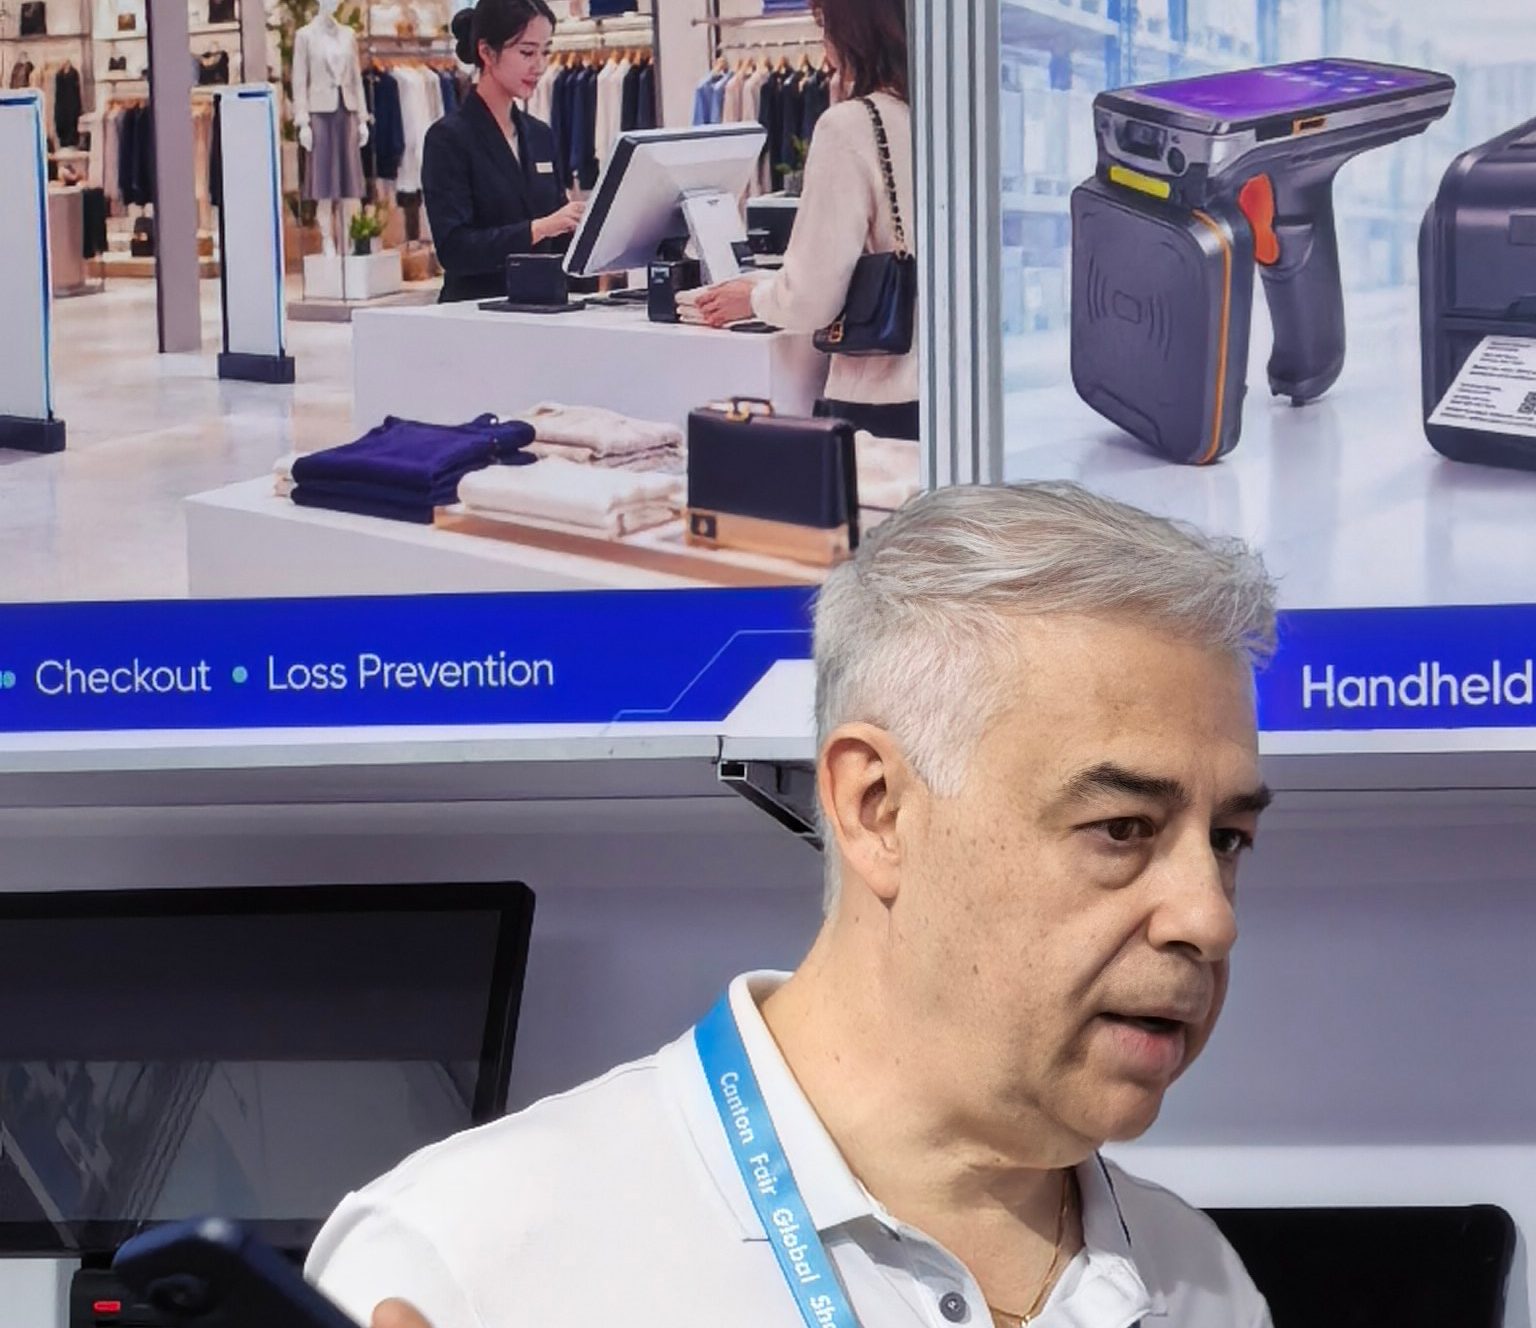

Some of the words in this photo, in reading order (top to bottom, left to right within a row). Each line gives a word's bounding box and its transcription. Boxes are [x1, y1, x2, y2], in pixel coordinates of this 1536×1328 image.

[35, 656, 213, 695] Checkout
[267, 654, 348, 690] Loss
[358, 650, 555, 690] Prevention
[1302, 659, 1533, 709] Handheld
[719, 1071, 756, 1146] Canton
[749, 1152, 777, 1197] Fair
[771, 1206, 822, 1284] Global
